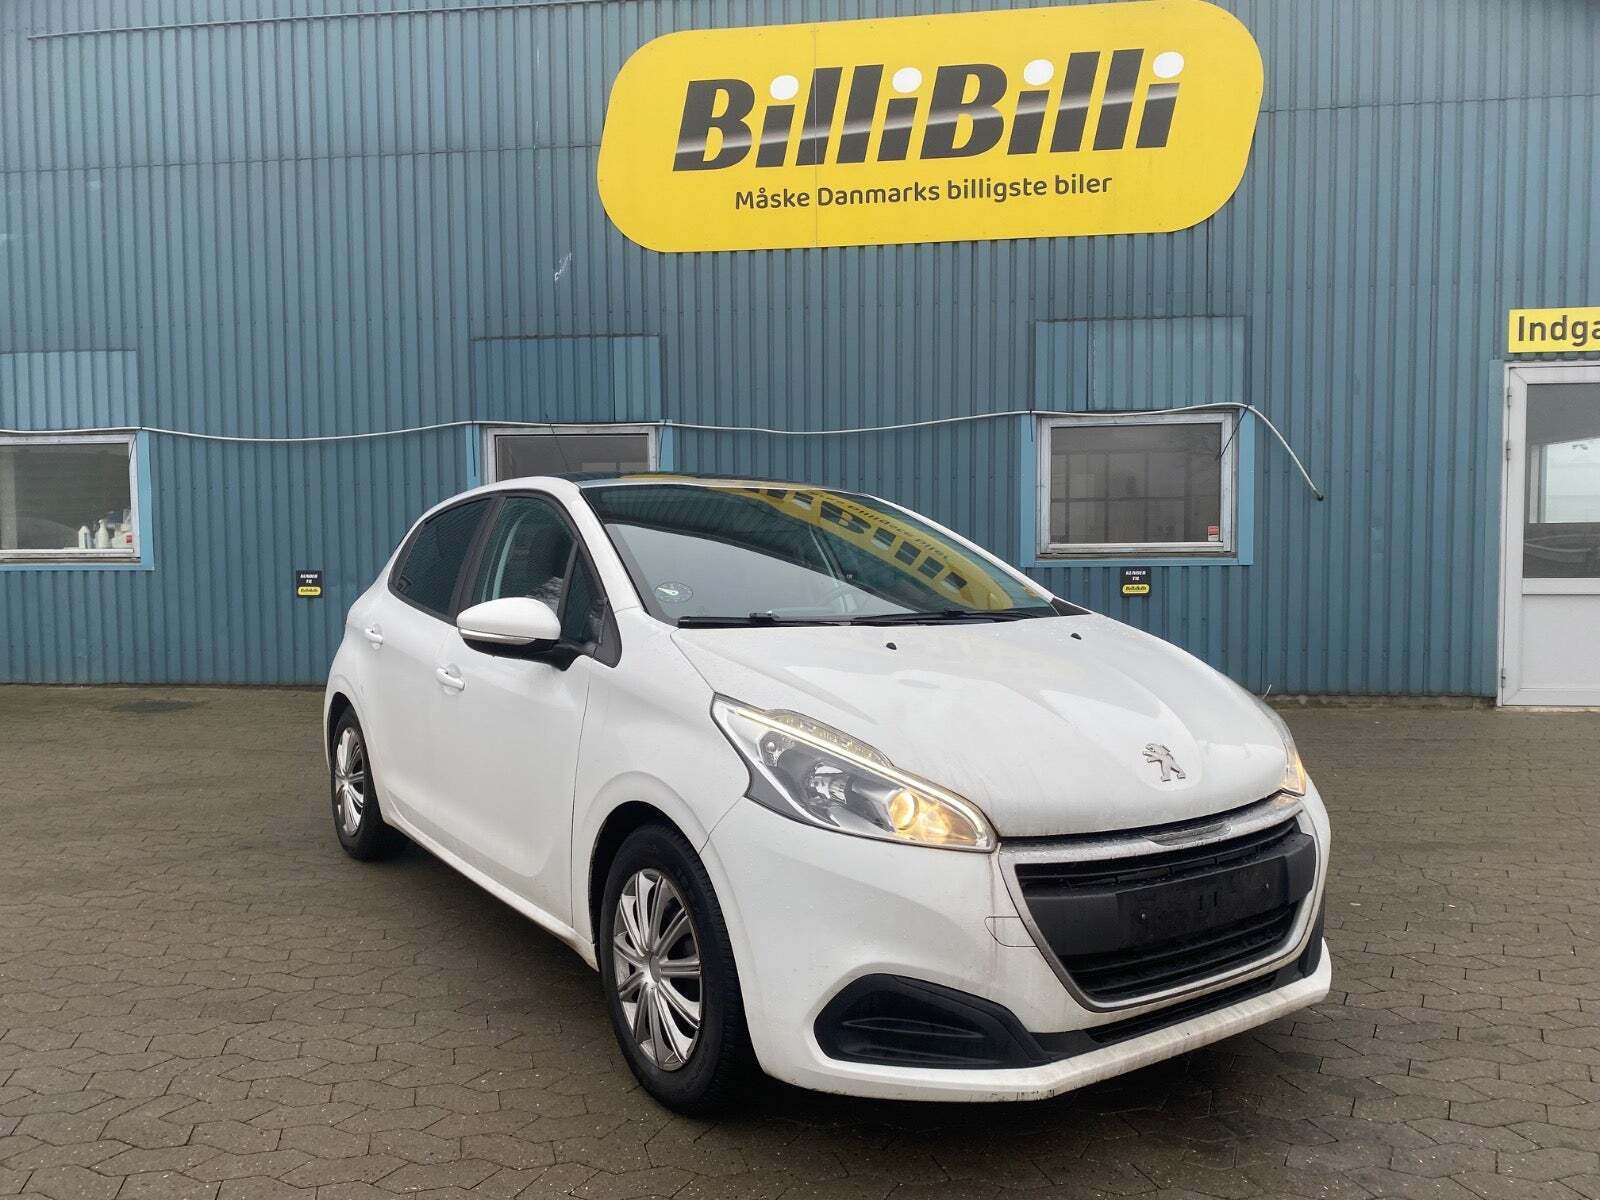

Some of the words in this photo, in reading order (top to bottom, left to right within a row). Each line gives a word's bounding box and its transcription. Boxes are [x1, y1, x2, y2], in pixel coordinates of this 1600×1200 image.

[671, 48, 1185, 172] BilliBilli
[735, 187, 810, 210] Måske
[817, 181, 940, 206] Danmarks
[947, 177, 1048, 203] billigste
[1055, 173, 1113, 195] biler
